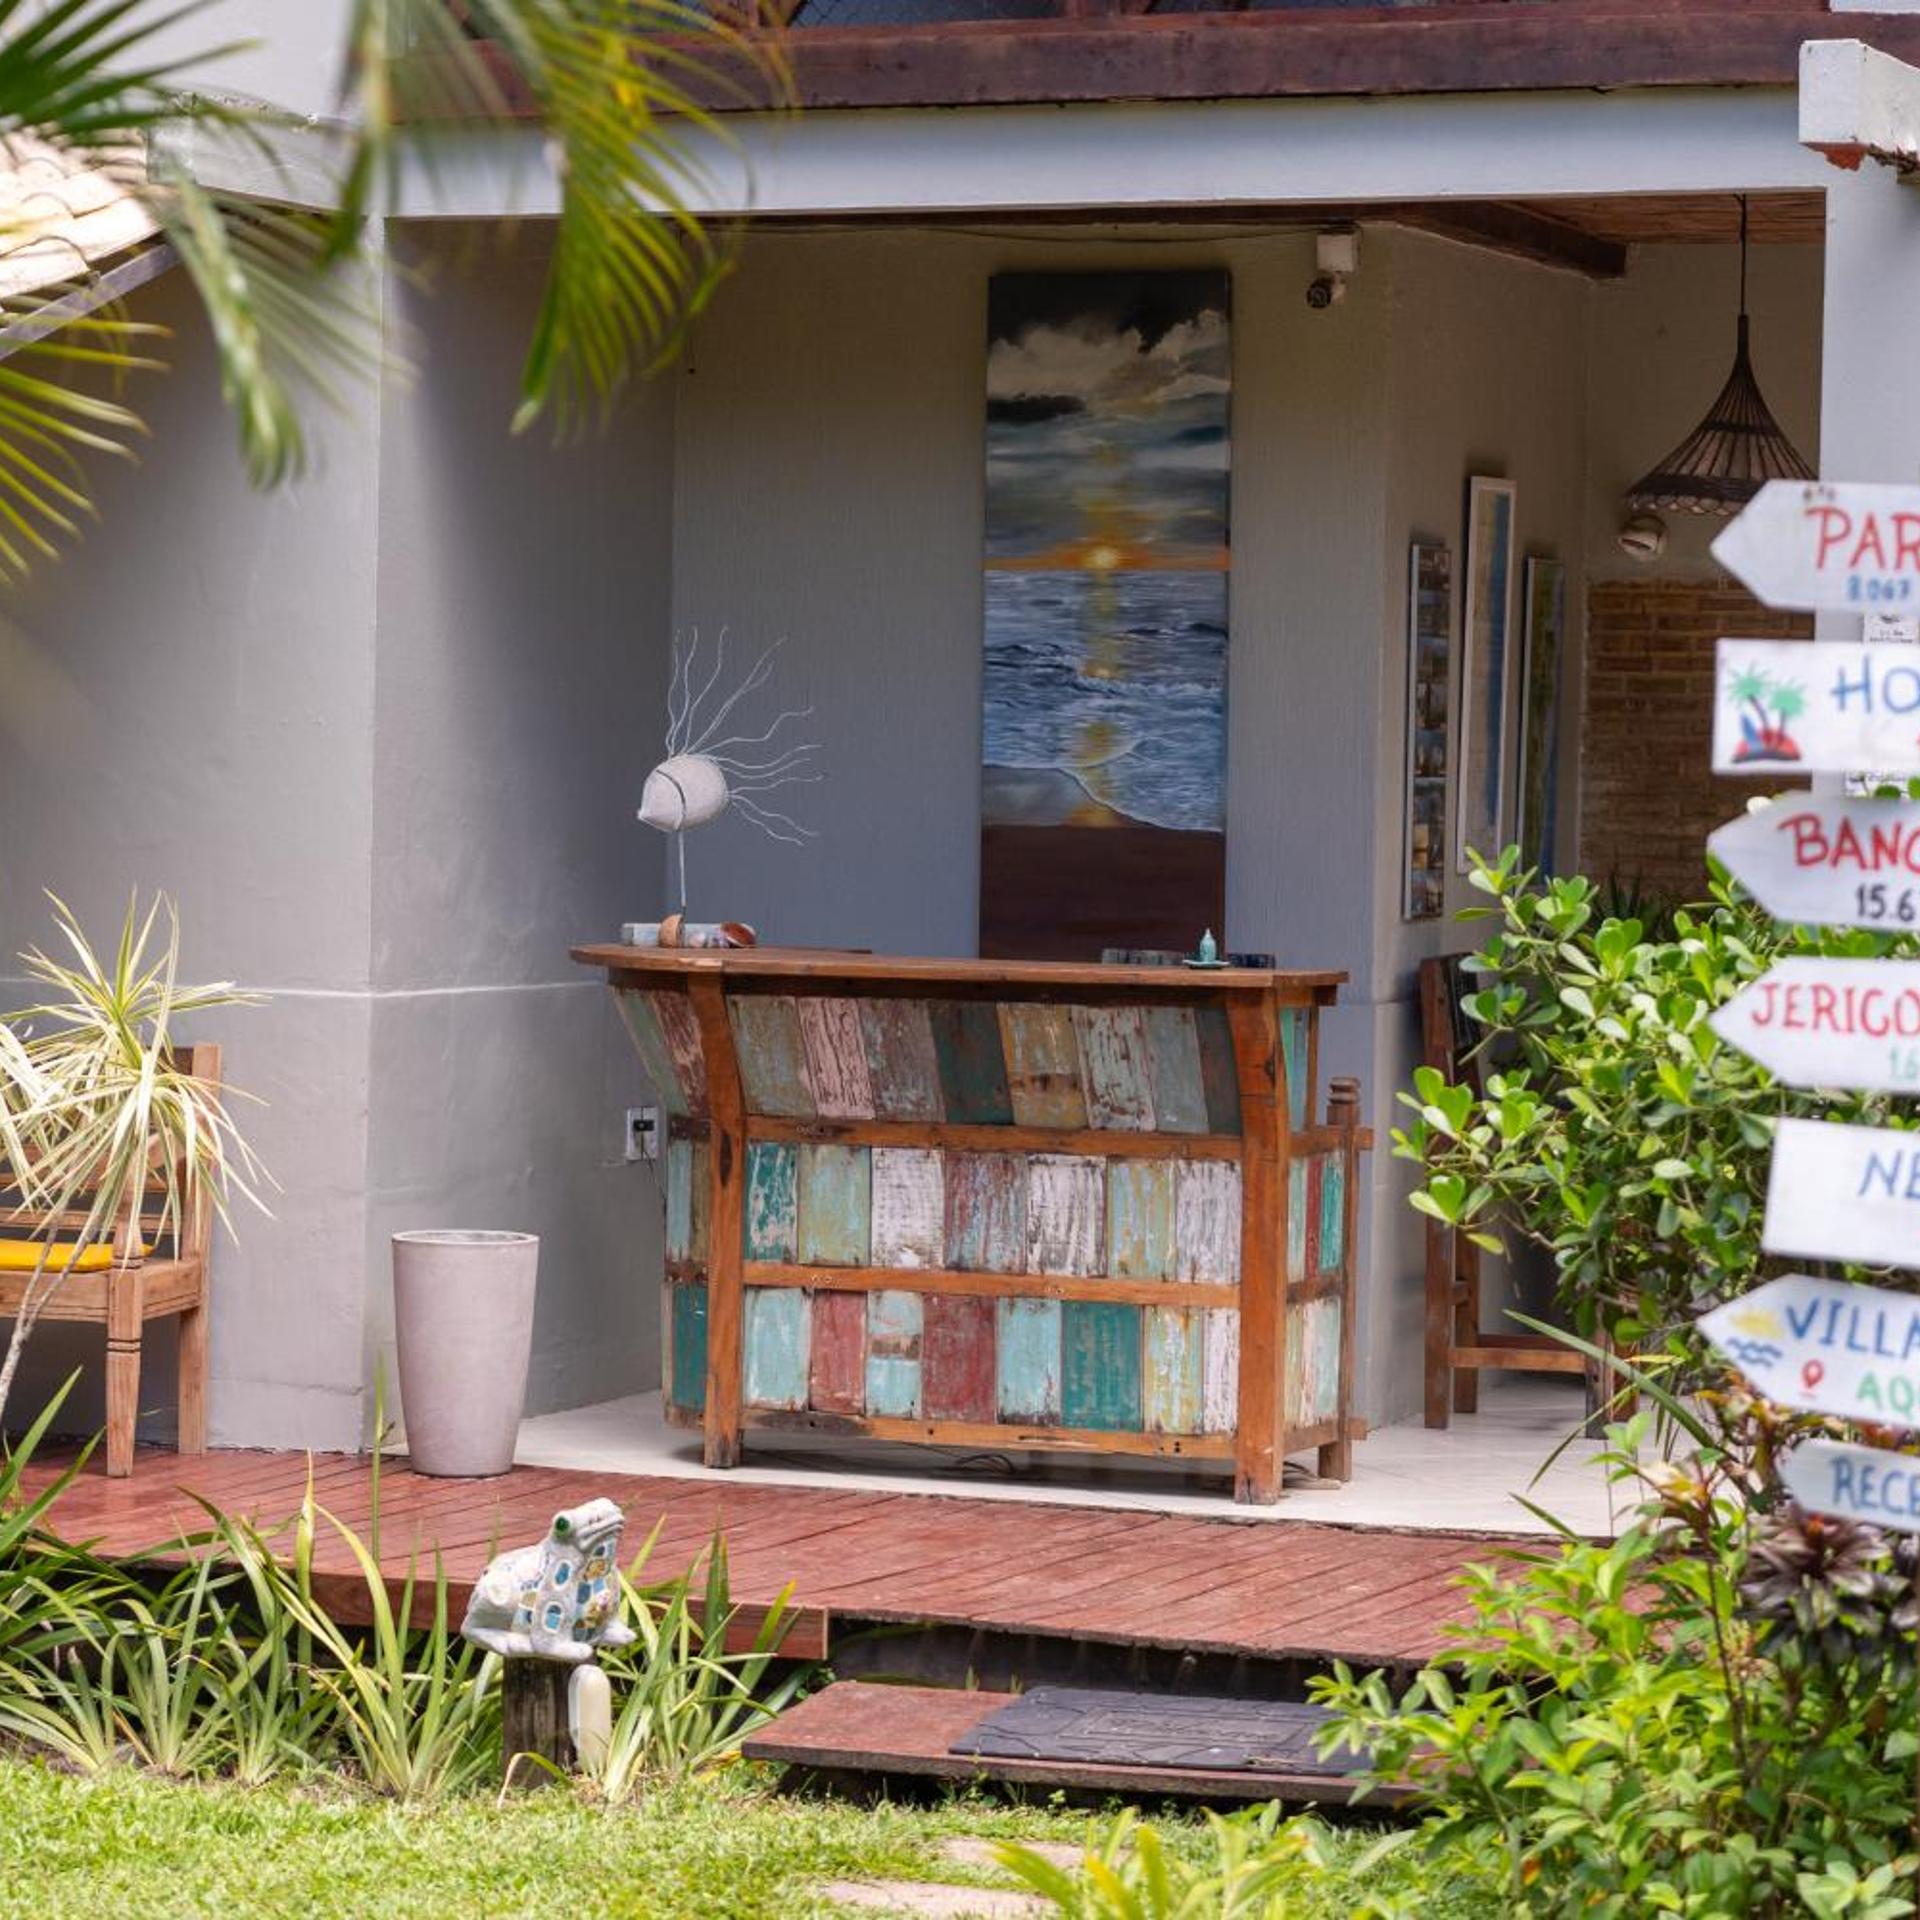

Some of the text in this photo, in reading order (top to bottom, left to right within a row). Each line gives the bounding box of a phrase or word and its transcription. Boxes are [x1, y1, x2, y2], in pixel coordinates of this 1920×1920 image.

[1804, 505, 1920, 570] PAR
[1830, 654, 1920, 715] HO
[1856, 1369, 1920, 1419] AQ
